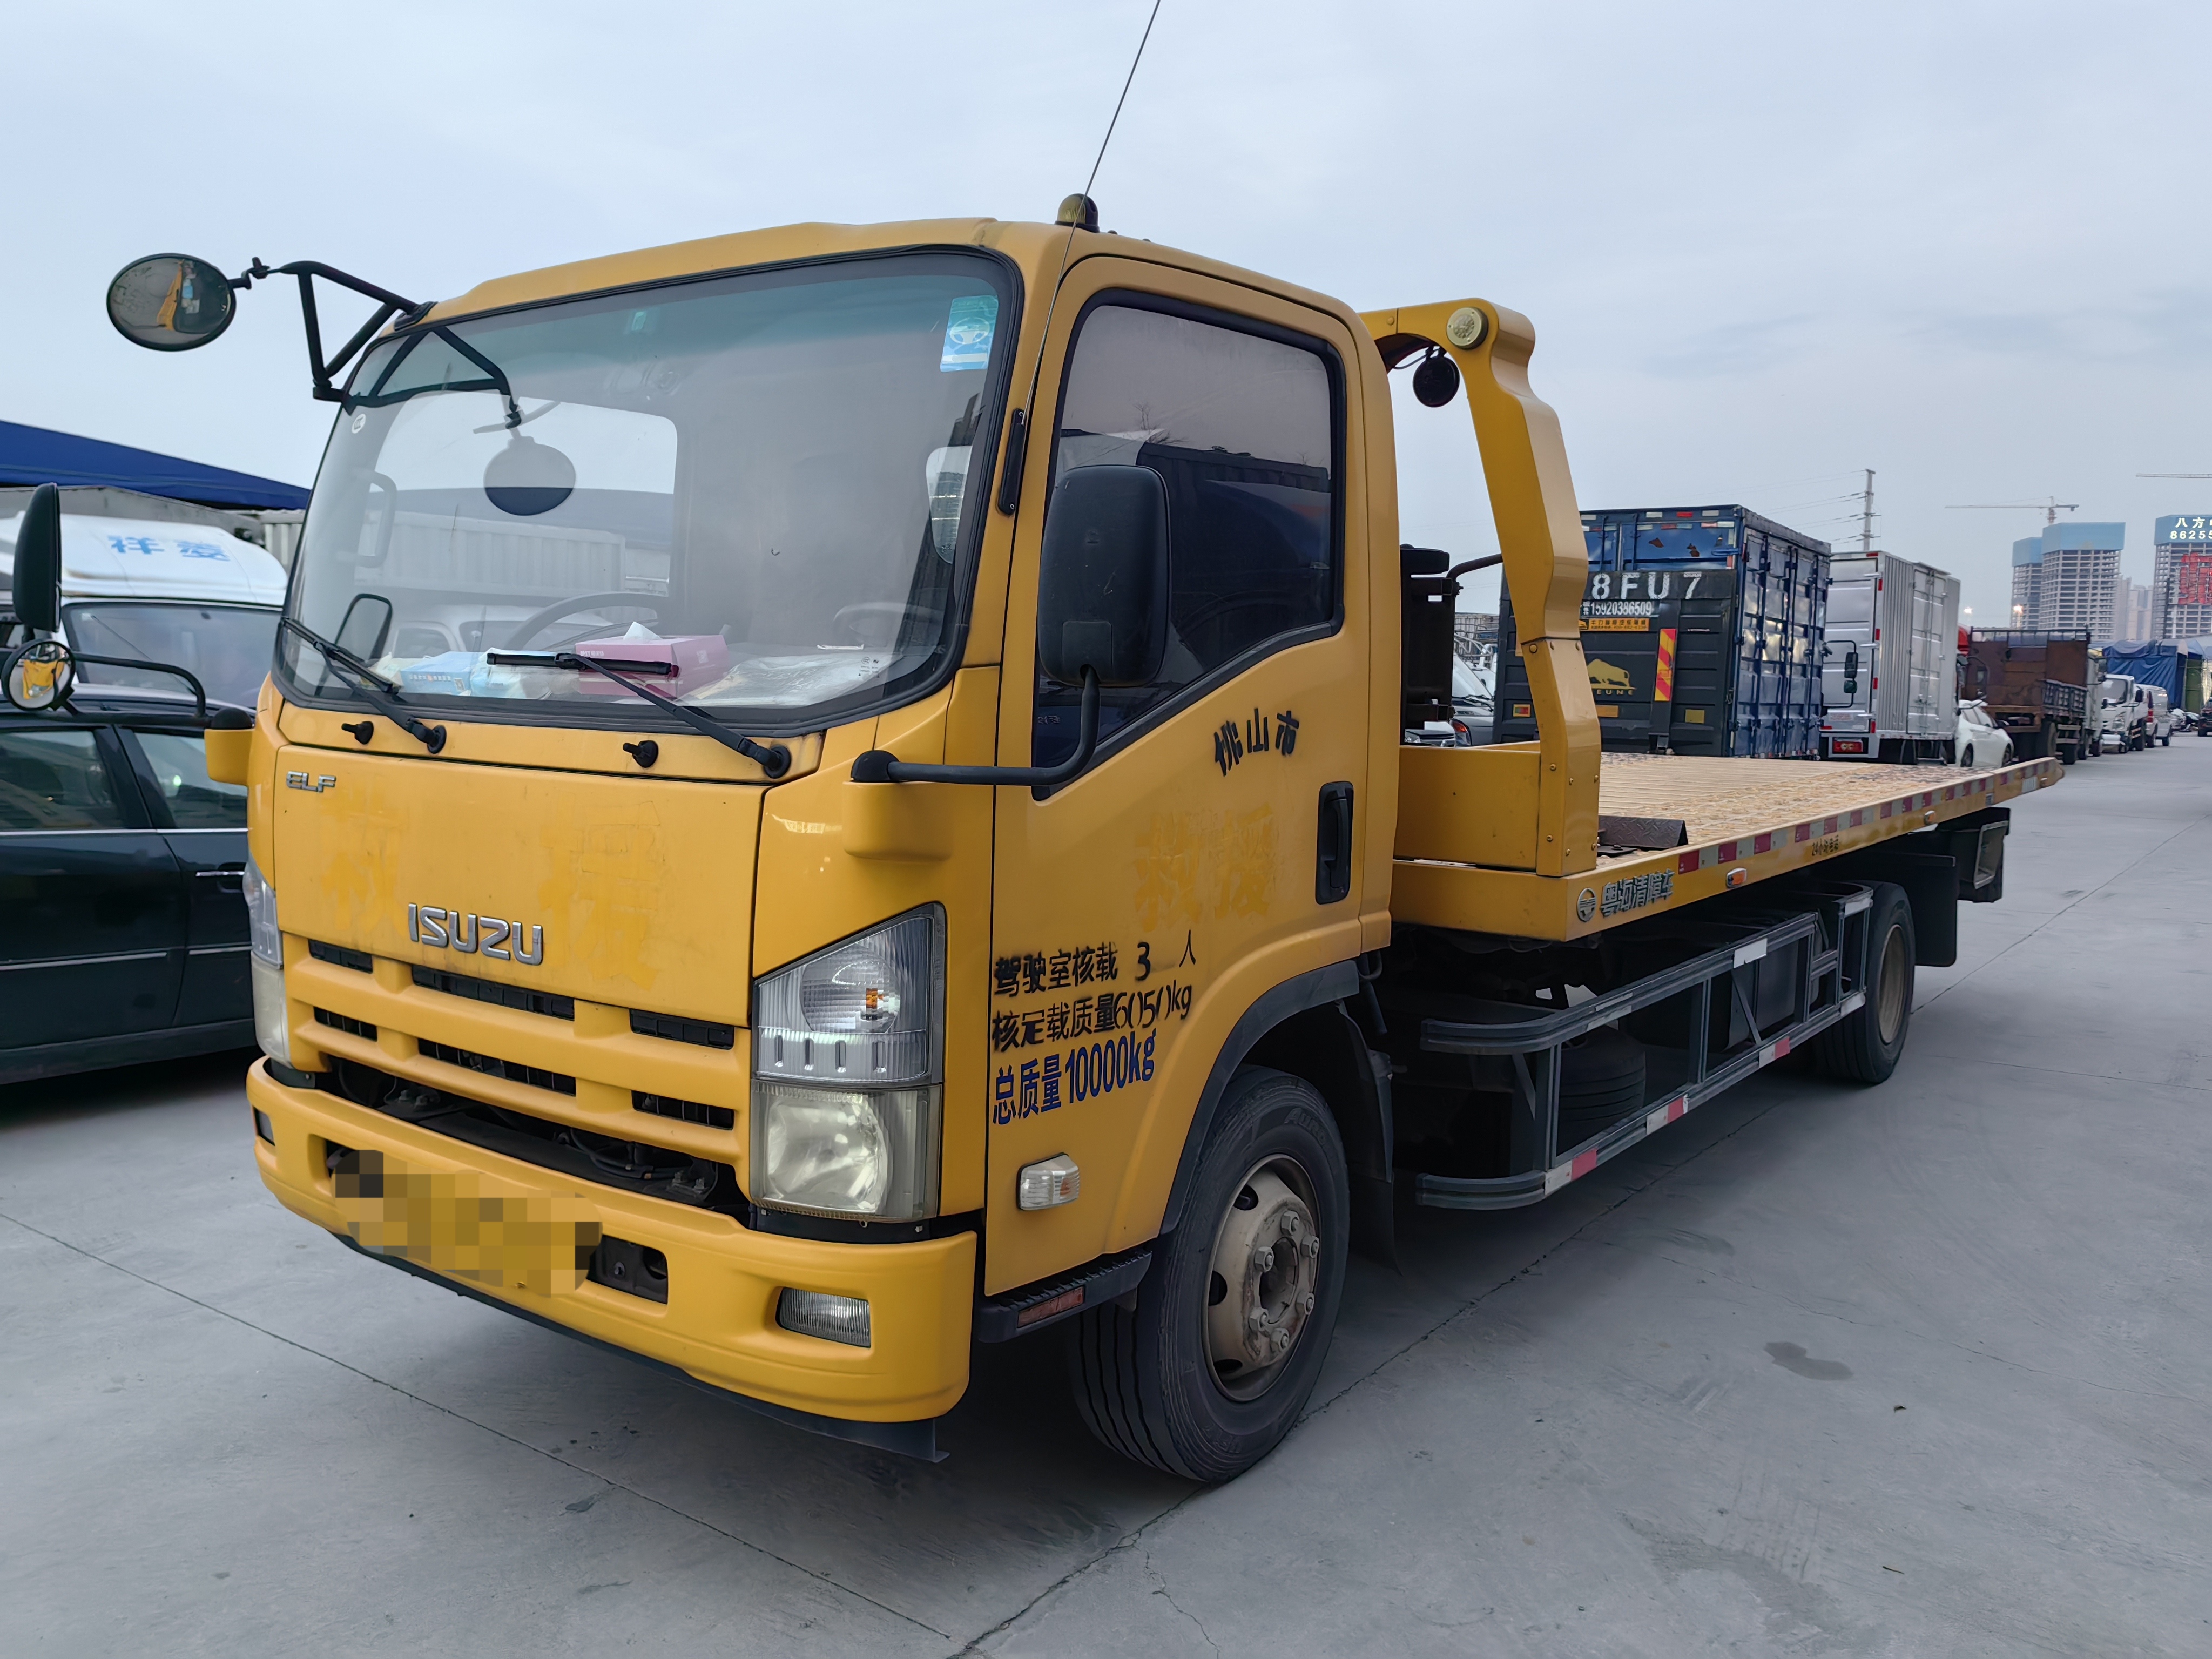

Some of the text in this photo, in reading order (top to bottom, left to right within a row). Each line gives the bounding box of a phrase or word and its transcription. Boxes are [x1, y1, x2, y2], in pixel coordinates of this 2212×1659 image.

[1591, 571, 1702, 600] 8FU7
[286, 771, 337, 793] ELF
[408, 902, 543, 966] ISUZU
[994, 929, 1196, 997] 驾驶室核载 3 人
